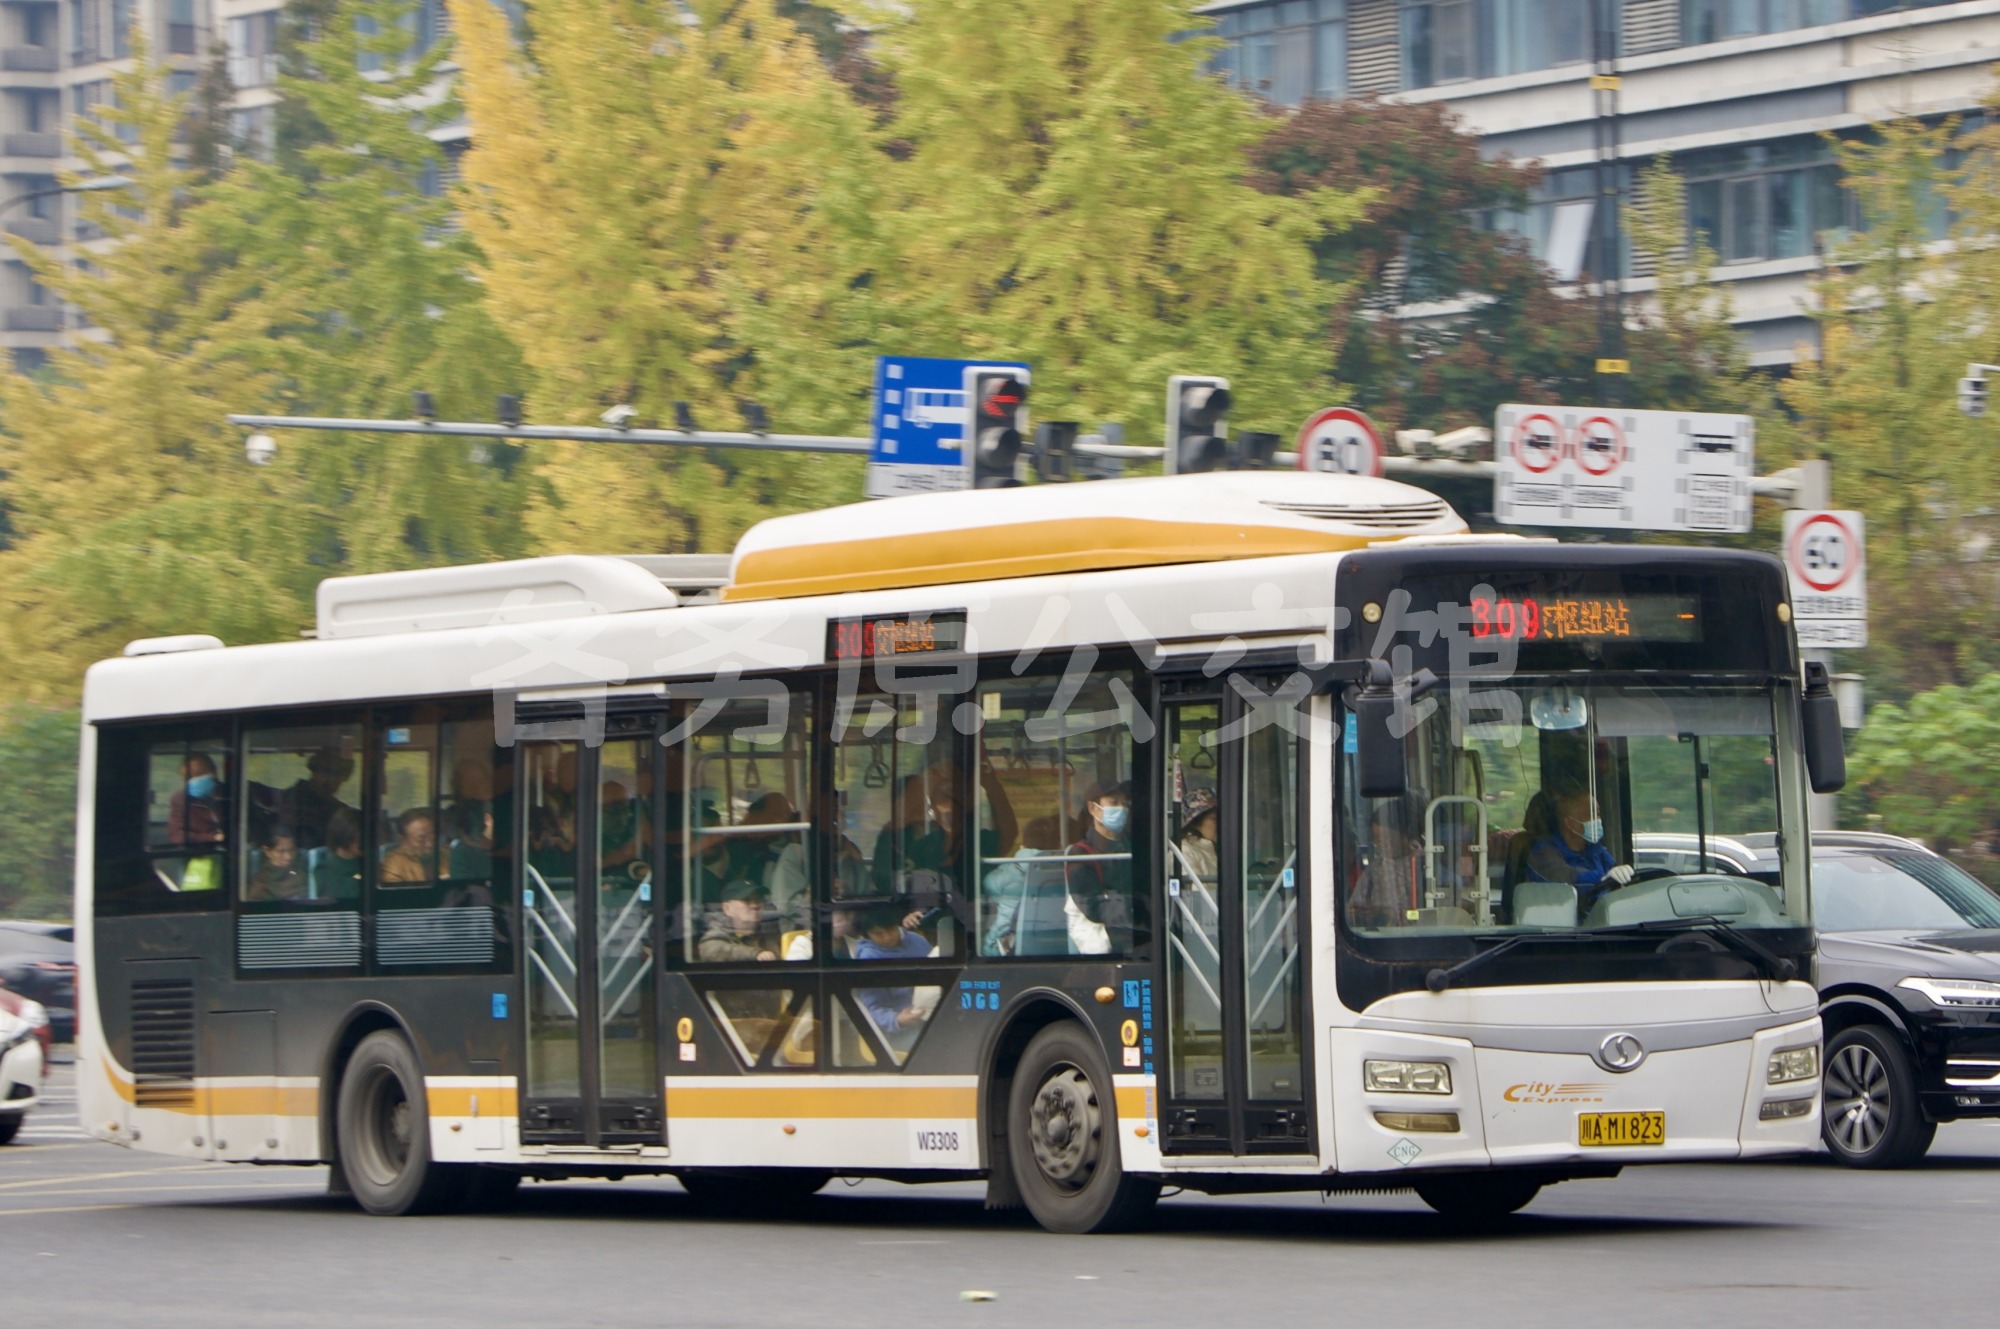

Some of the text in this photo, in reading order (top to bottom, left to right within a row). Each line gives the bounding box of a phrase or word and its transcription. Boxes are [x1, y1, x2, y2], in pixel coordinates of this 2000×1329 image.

[1471, 598, 1539, 639] 309
[1503, 1081, 1556, 1102] City
[917, 1131, 959, 1150] W3308
[1393, 1145, 1417, 1158] CNG
